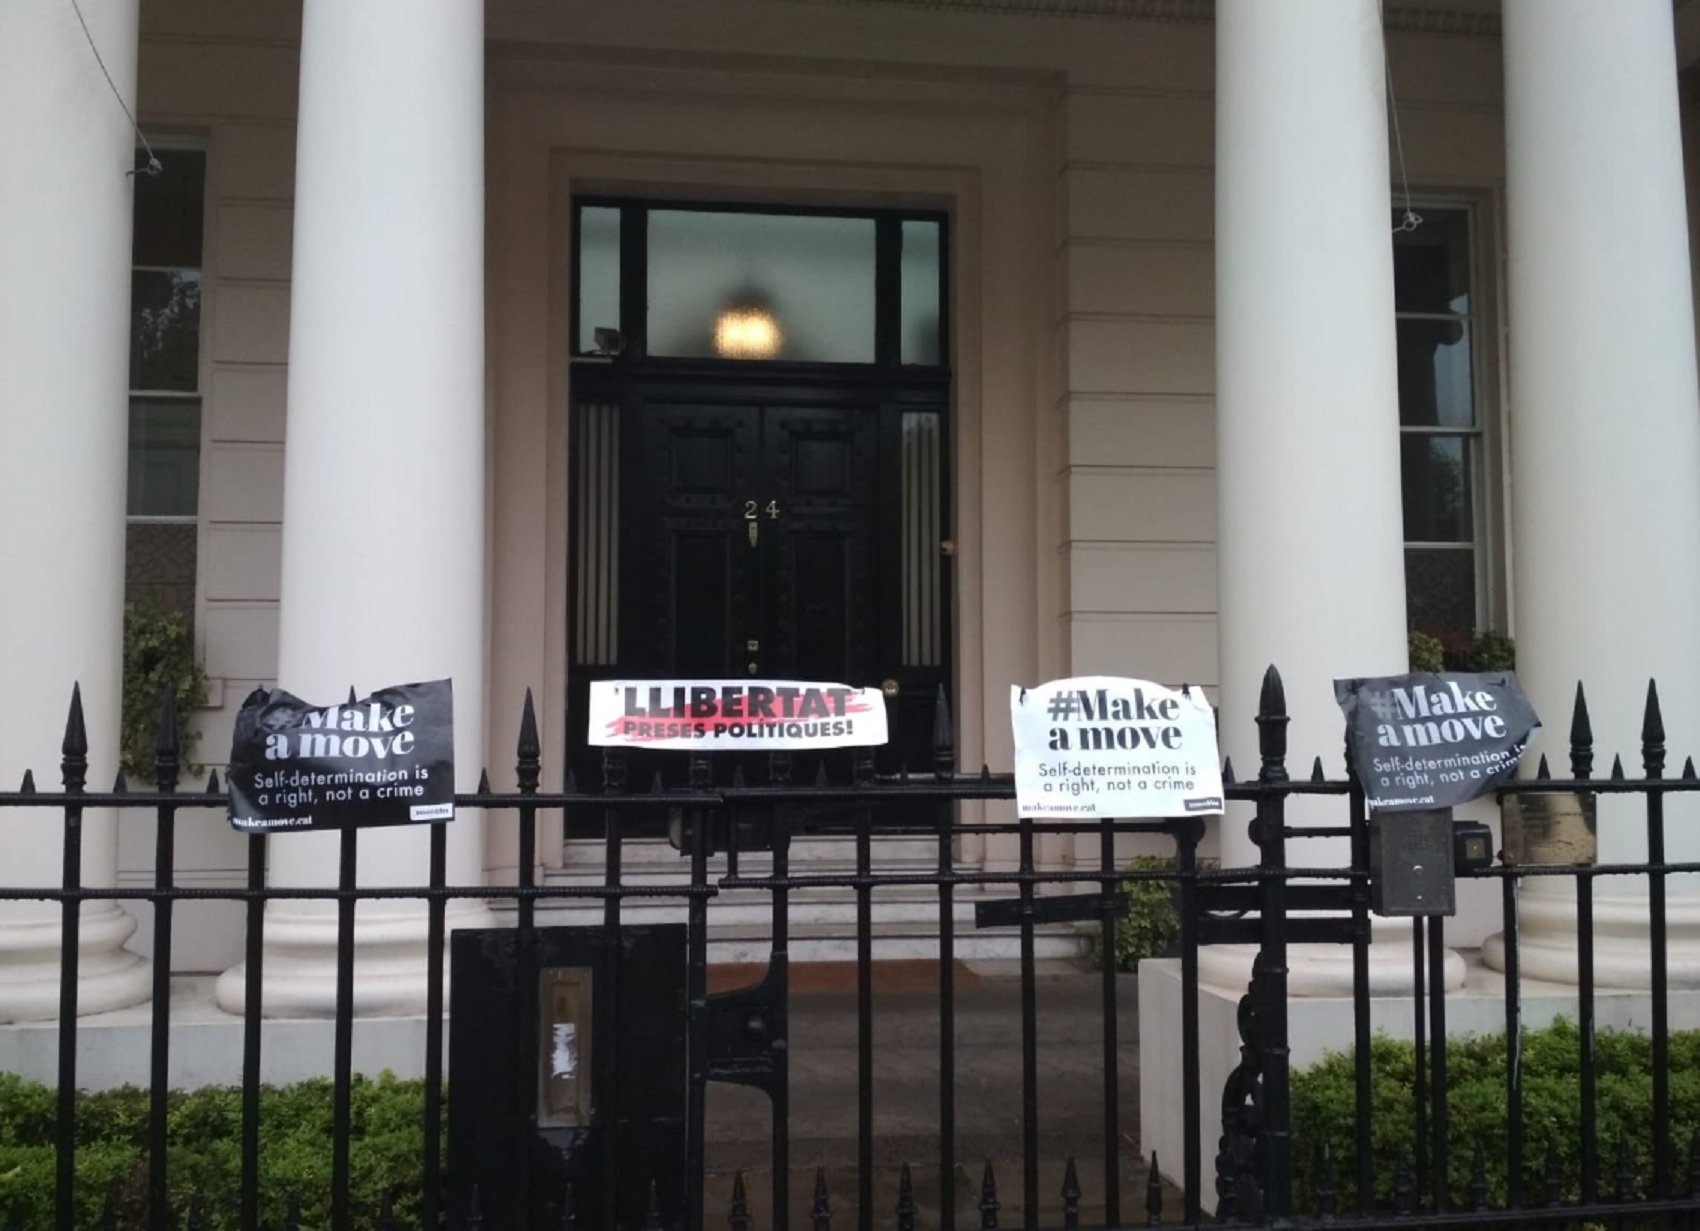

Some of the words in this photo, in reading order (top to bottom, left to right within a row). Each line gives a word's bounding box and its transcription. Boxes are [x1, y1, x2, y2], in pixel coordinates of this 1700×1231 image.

[744, 500, 780, 519] 24
[624, 686, 851, 718] LLIBERTAT
[1047, 688, 1180, 722] #Make
[1371, 681, 1497, 720] #Make
[623, 720, 705, 738] PRESES
[1048, 727, 1072, 751] a
[1079, 726, 1183, 750] move
[1377, 723, 1402, 747] a
[1402, 715, 1507, 747] move
[264, 733, 292, 760] a
[298, 730, 415, 759] move
[1039, 761, 1179, 777] Self-determination
[1185, 763, 1196, 776] is
[1374, 750, 1510, 772] Self-determination
[254, 768, 408, 789] Self-determination
[415, 765, 429, 780] is
[1043, 782, 1053, 792] a
[1059, 778, 1099, 796] right,
[1107, 778, 1131, 791] not
[1138, 780, 1147, 790] a
[1154, 777, 1194, 790] crime
[1381, 776, 1390, 787] a
[1395, 772, 1435, 789] right,
[1440, 770, 1465, 783] not
[1470, 769, 1481, 779] a
[258, 794, 269, 805] a
[276, 788, 318, 808] right,
[326, 788, 353, 801] not
[359, 789, 370, 799] a
[377, 782, 424, 798] crime
